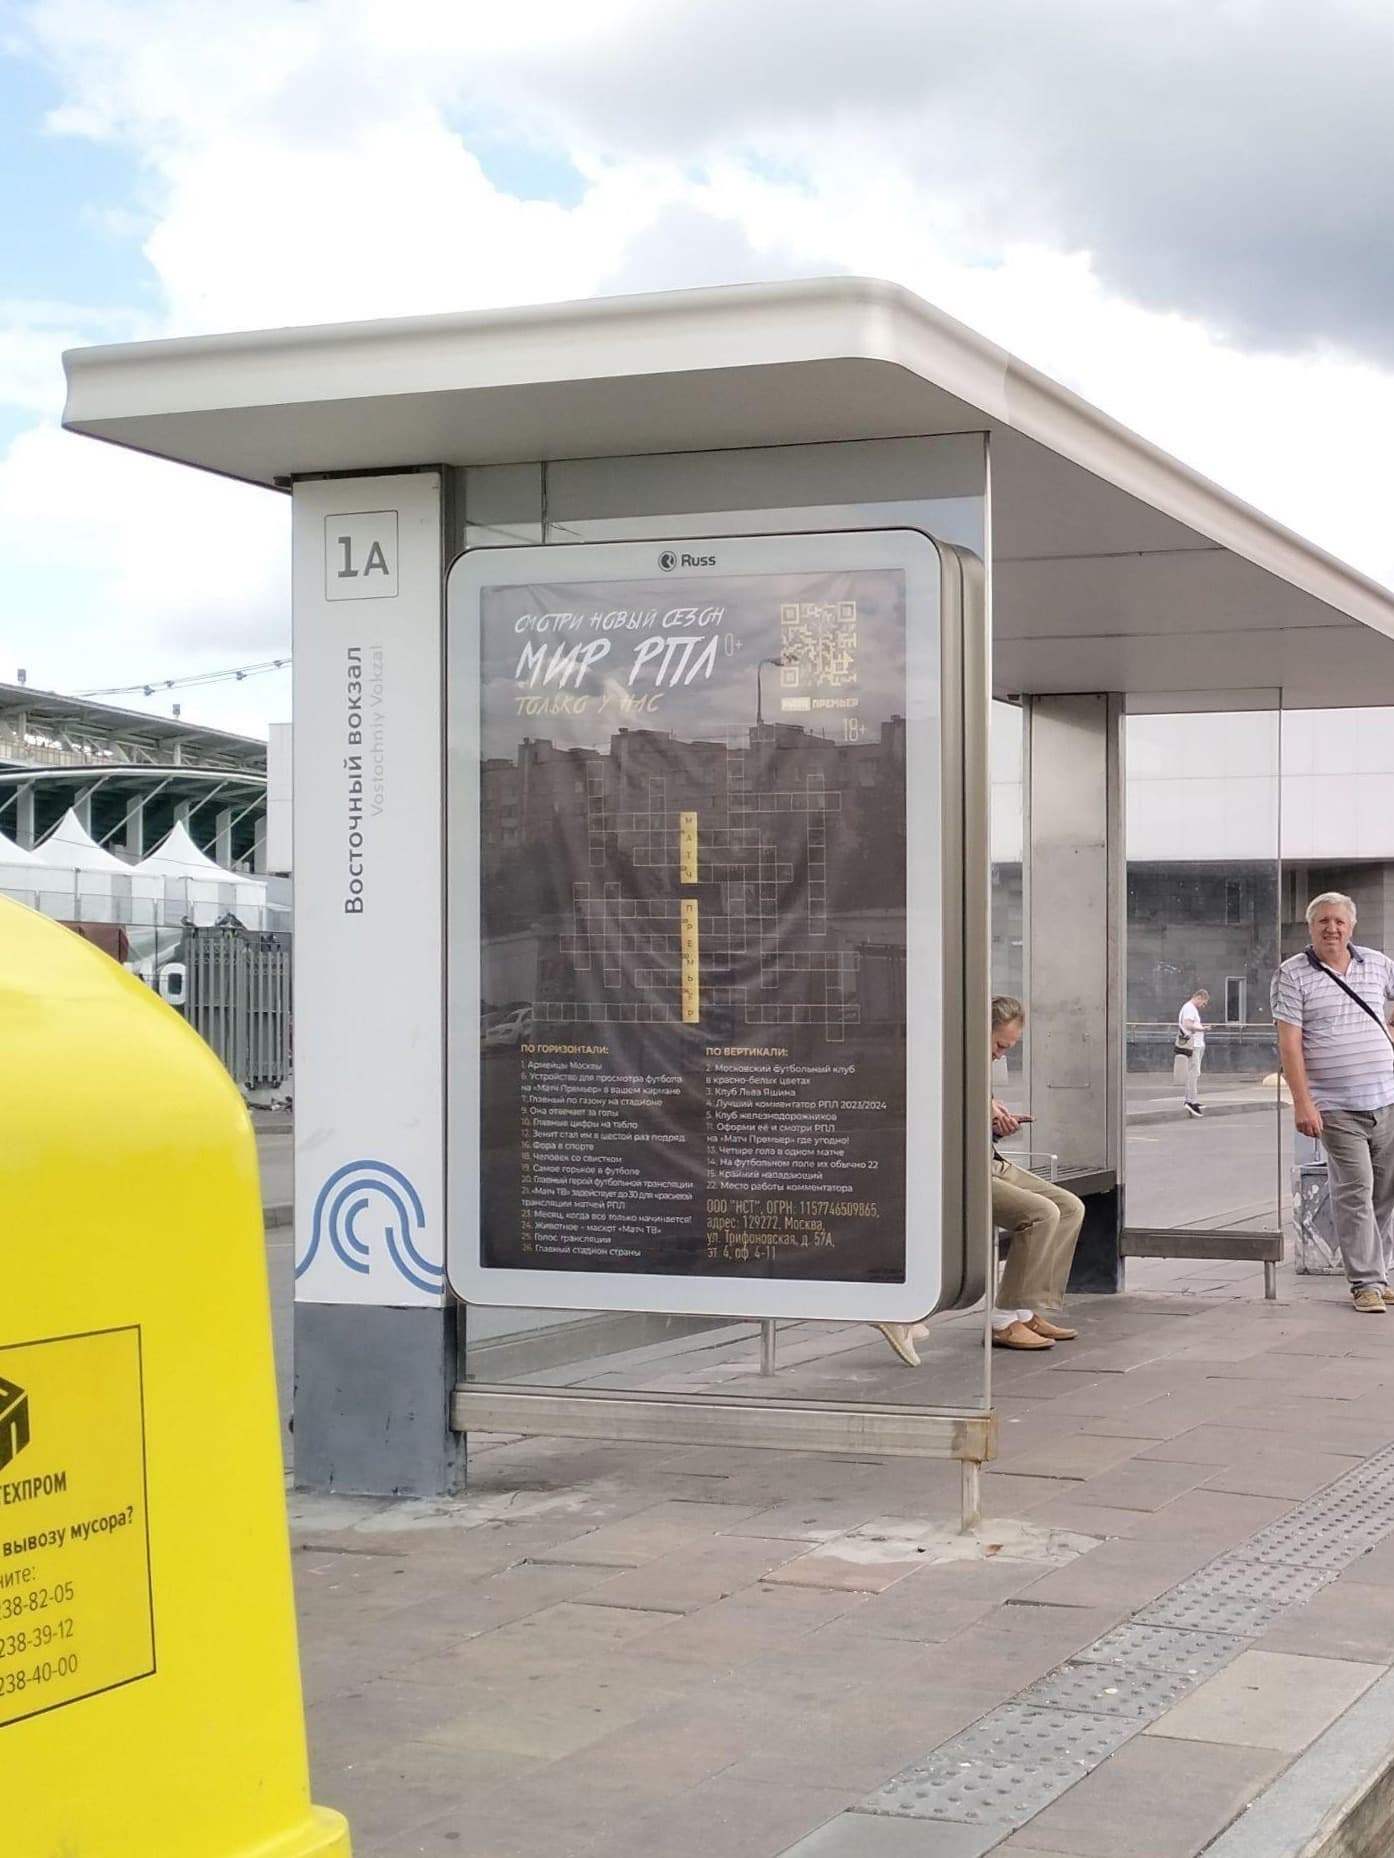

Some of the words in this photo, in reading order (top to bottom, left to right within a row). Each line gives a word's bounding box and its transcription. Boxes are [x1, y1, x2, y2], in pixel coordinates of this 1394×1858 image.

[681, 554, 716, 566] Russ
[514, 613, 584, 633] СМОТРИ
[590, 608, 658, 631] НОВЫЙ
[662, 607, 725, 629] СЕЗОН
[515, 637, 612, 689] МИР
[627, 634, 720, 688] РПЛ
[369, 644, 384, 707] Vokzal
[347, 647, 362, 745] вокзал
[515, 694, 588, 715] ТОЛЬКО
[597, 694, 611, 714] У
[620, 692, 665, 714] НАС
[844, 718, 865, 742] 18+
[370, 711, 385, 817] Vostochniy
[343, 755, 363, 914] Восточный
[521, 1044, 535, 1053] ПО
[537, 1044, 609, 1054] ГОРИЗОНТАЛИ:
[706, 1048, 721, 1056] ПО
[724, 1048, 789, 1057] ВЕРТИКАЛИ:
[706, 1199, 727, 1213] ООО
[2, 1527, 66, 1557] вывозу
[70, 1505, 134, 1541] мусора?
[0, 1566, 36, 1589] ните:
[0, 1581, 74, 1620] 38-82-05
